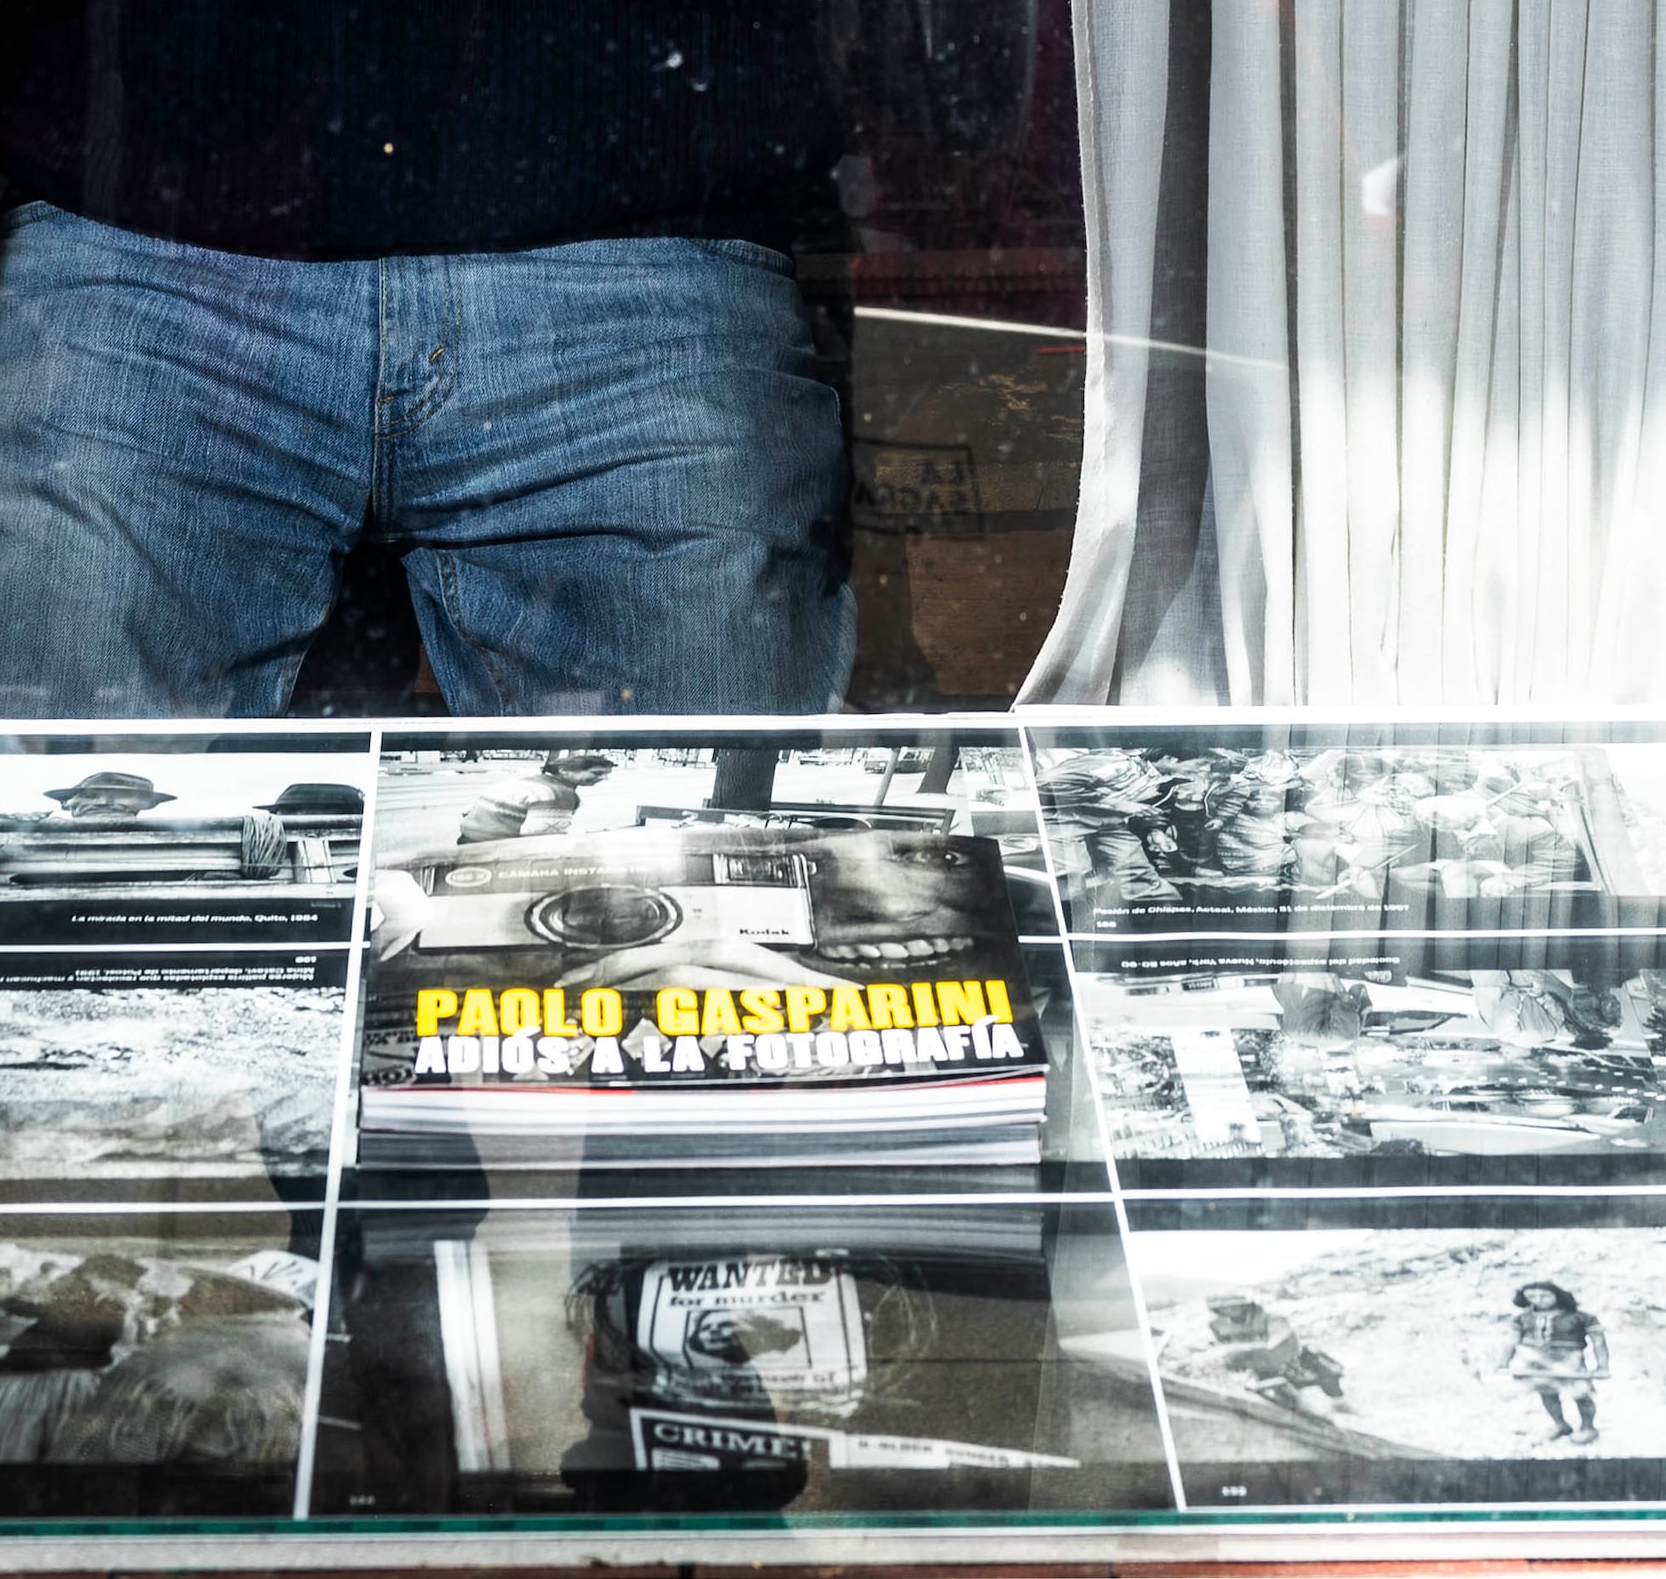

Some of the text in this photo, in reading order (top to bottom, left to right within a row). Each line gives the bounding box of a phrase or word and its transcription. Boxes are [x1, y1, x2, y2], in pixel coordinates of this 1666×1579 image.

[1131, 906, 1146, 914] de
[71, 914, 86, 922] La
[87, 914, 127, 922] mirada
[128, 915, 143, 923] en
[144, 914, 155, 922] la
[156, 914, 190, 922] mitad
[191, 913, 209, 922] del
[738, 928, 791, 936] Kodak
[1329, 957, 1347, 965] del
[415, 980, 1015, 1037] PAOLO GASPARINI
[415, 1013, 1026, 1074] ADIÓS A LA FOTOGRAFÍA
[666, 1259, 835, 1292] WANTED
[668, 1290, 825, 1307] for murder
